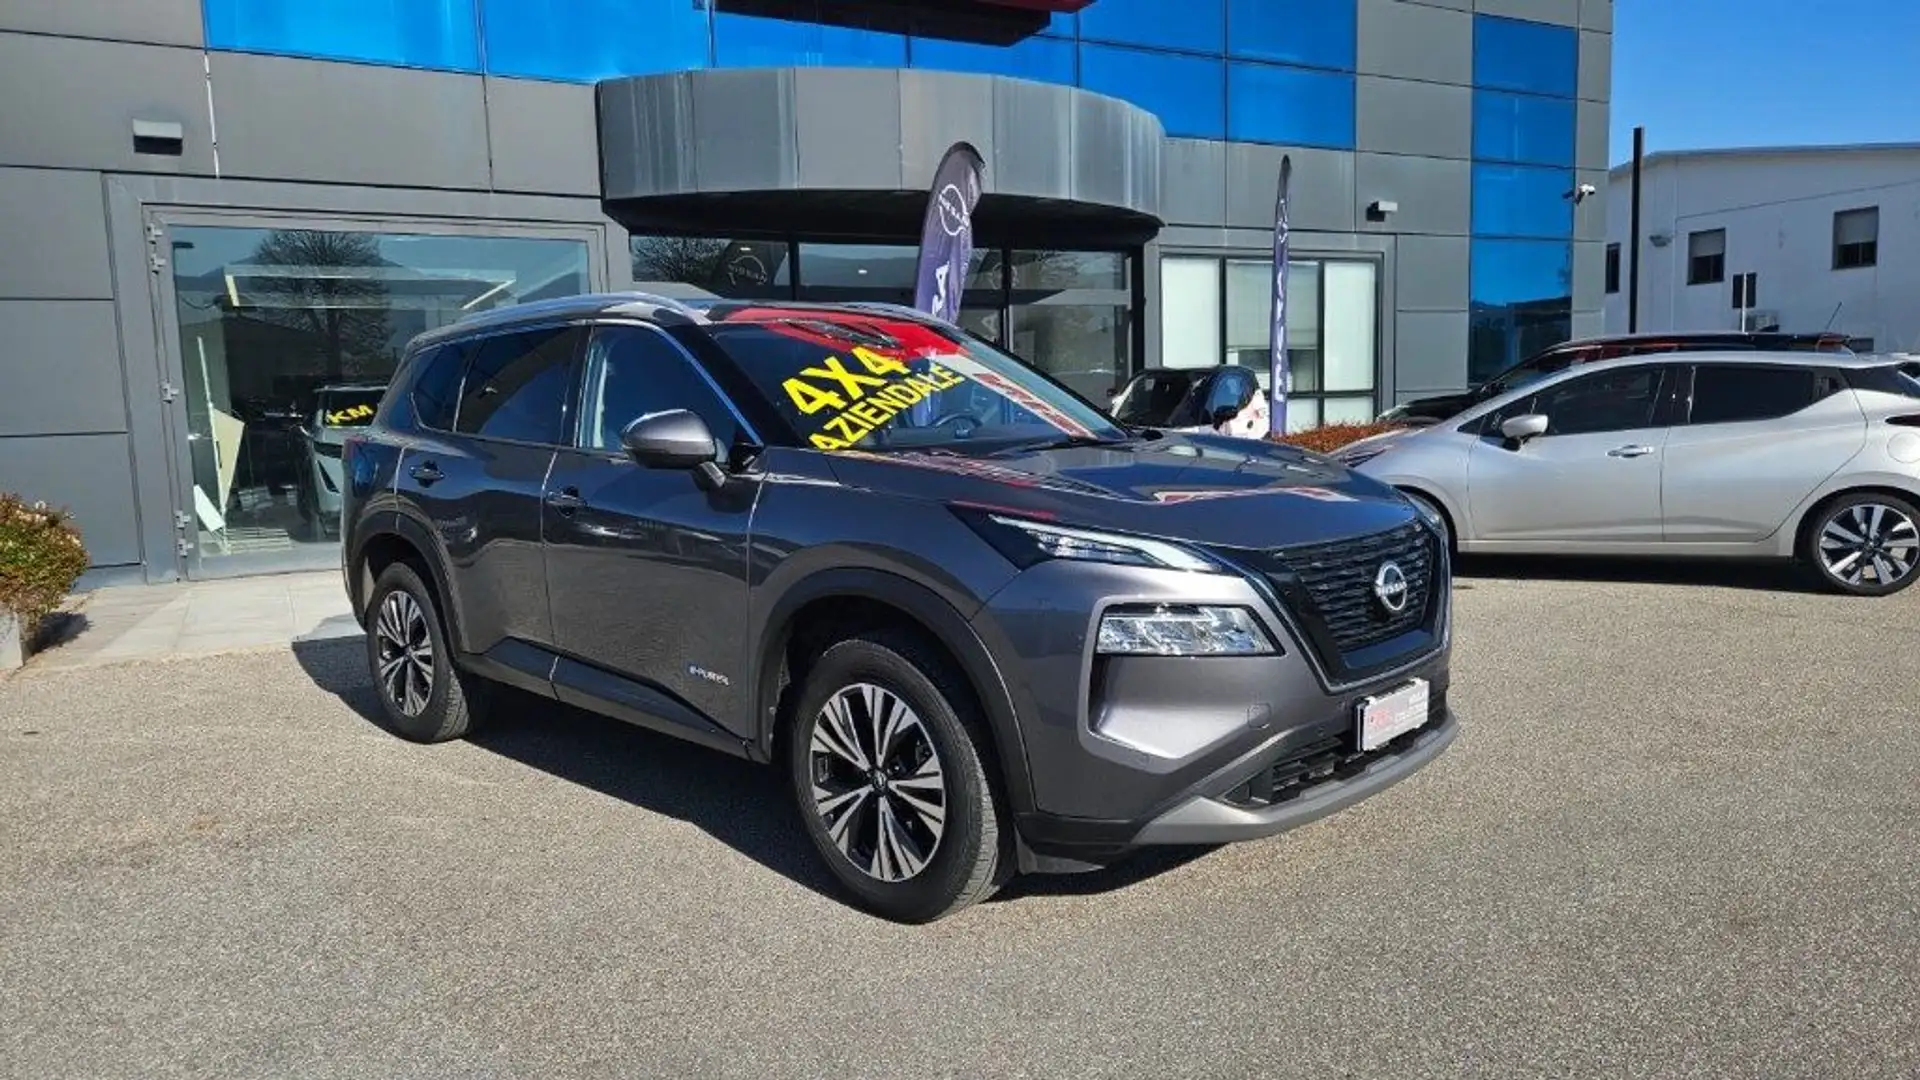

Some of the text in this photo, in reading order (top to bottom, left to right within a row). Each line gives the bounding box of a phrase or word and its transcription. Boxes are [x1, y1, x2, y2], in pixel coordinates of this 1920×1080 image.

[326, 404, 373, 424] KM
[782, 346, 911, 415] 4X4
[808, 363, 965, 450] AZIENDALE
